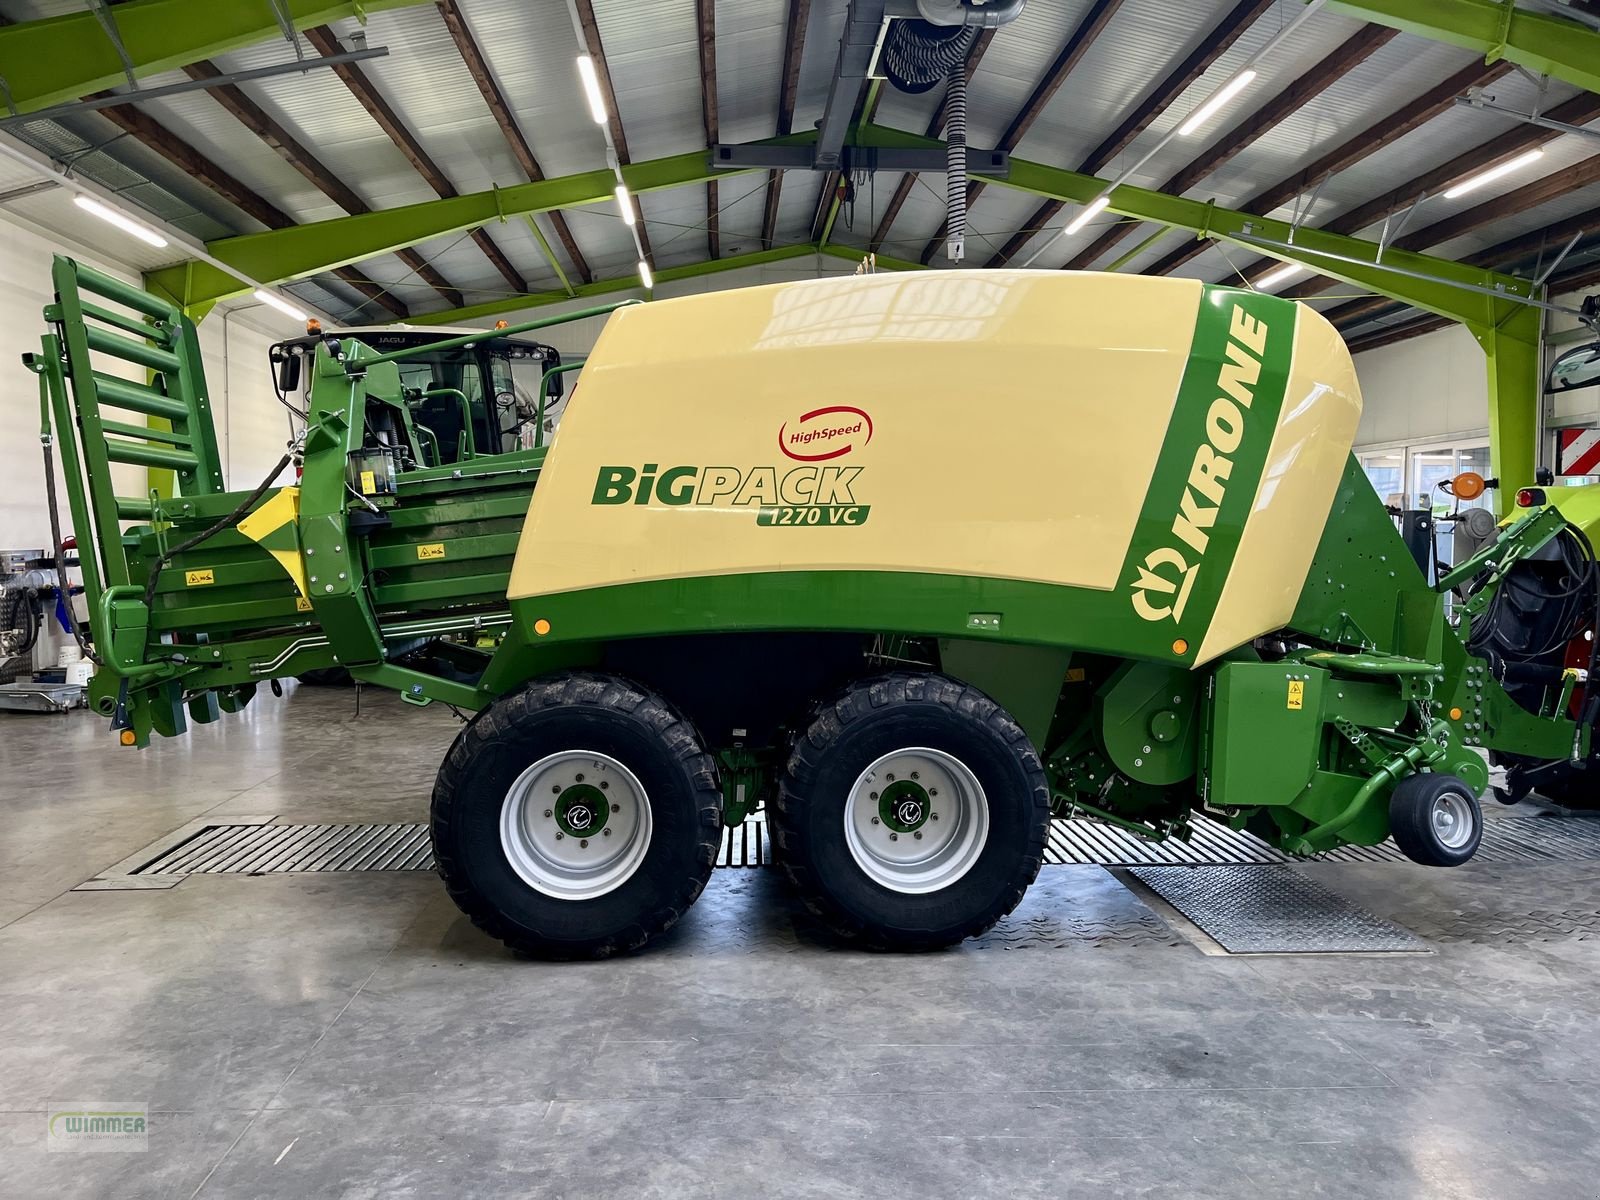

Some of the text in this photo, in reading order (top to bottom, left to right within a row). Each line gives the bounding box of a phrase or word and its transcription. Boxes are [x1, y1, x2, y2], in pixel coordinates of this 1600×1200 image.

[790, 422, 862, 444] HighSpeed
[1171, 304, 1268, 555] KRONE
[769, 507, 859, 525] 1270 VC
